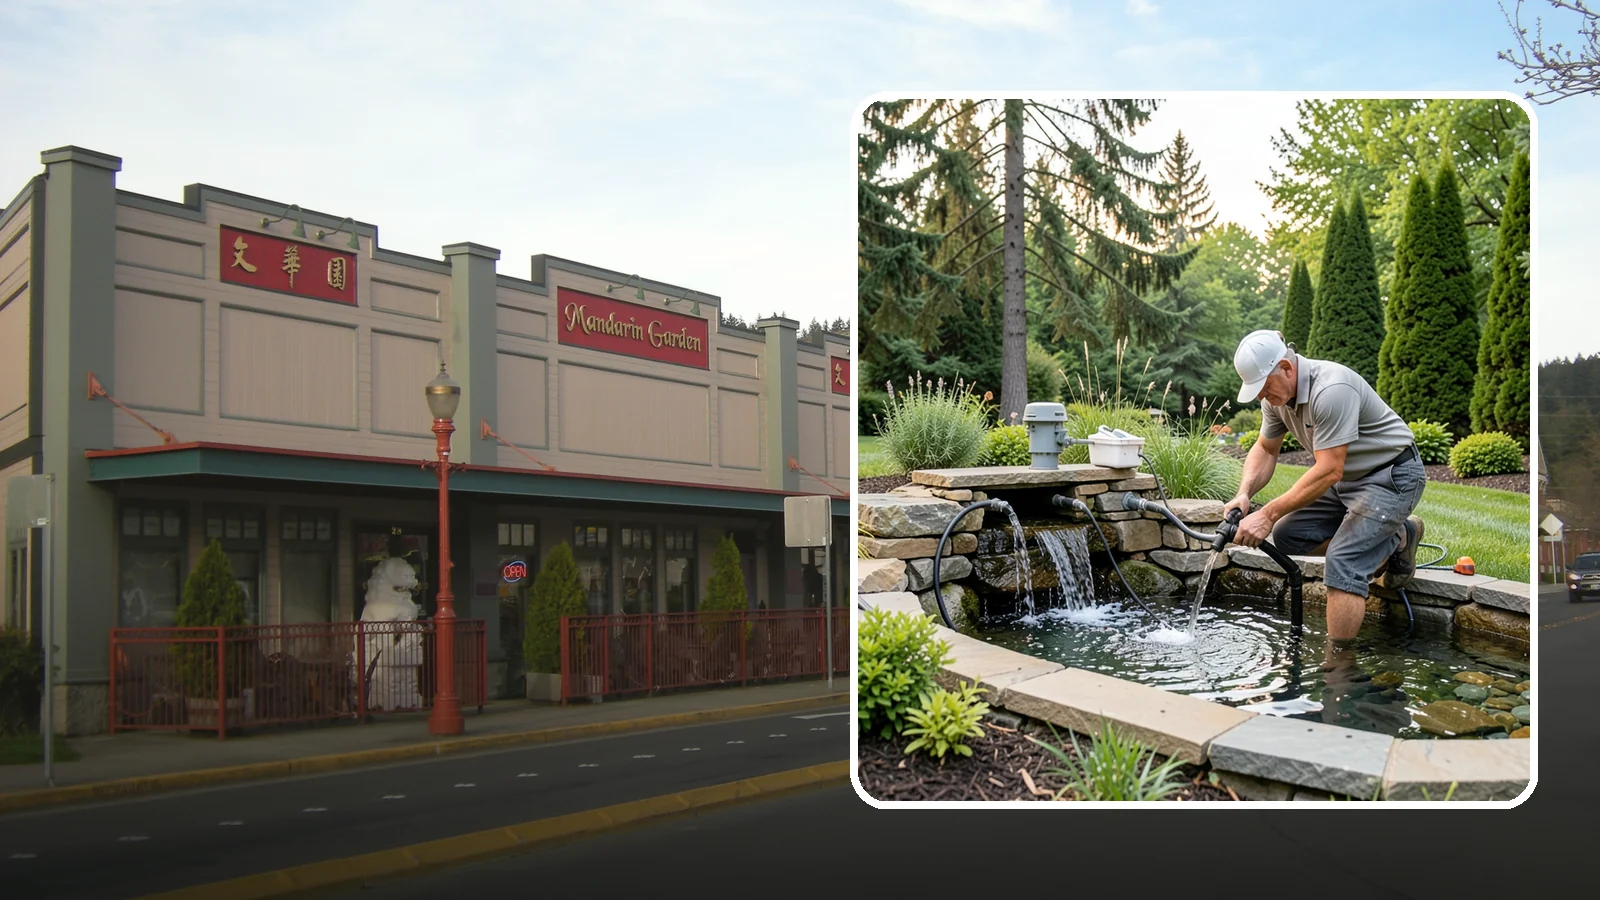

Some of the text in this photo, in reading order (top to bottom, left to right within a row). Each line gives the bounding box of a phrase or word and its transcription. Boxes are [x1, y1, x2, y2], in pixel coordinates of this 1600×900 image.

[231, 236, 346, 291] 文華園
[565, 302, 701, 352] Mandarin Garden
[503, 565, 527, 578] OPEN
